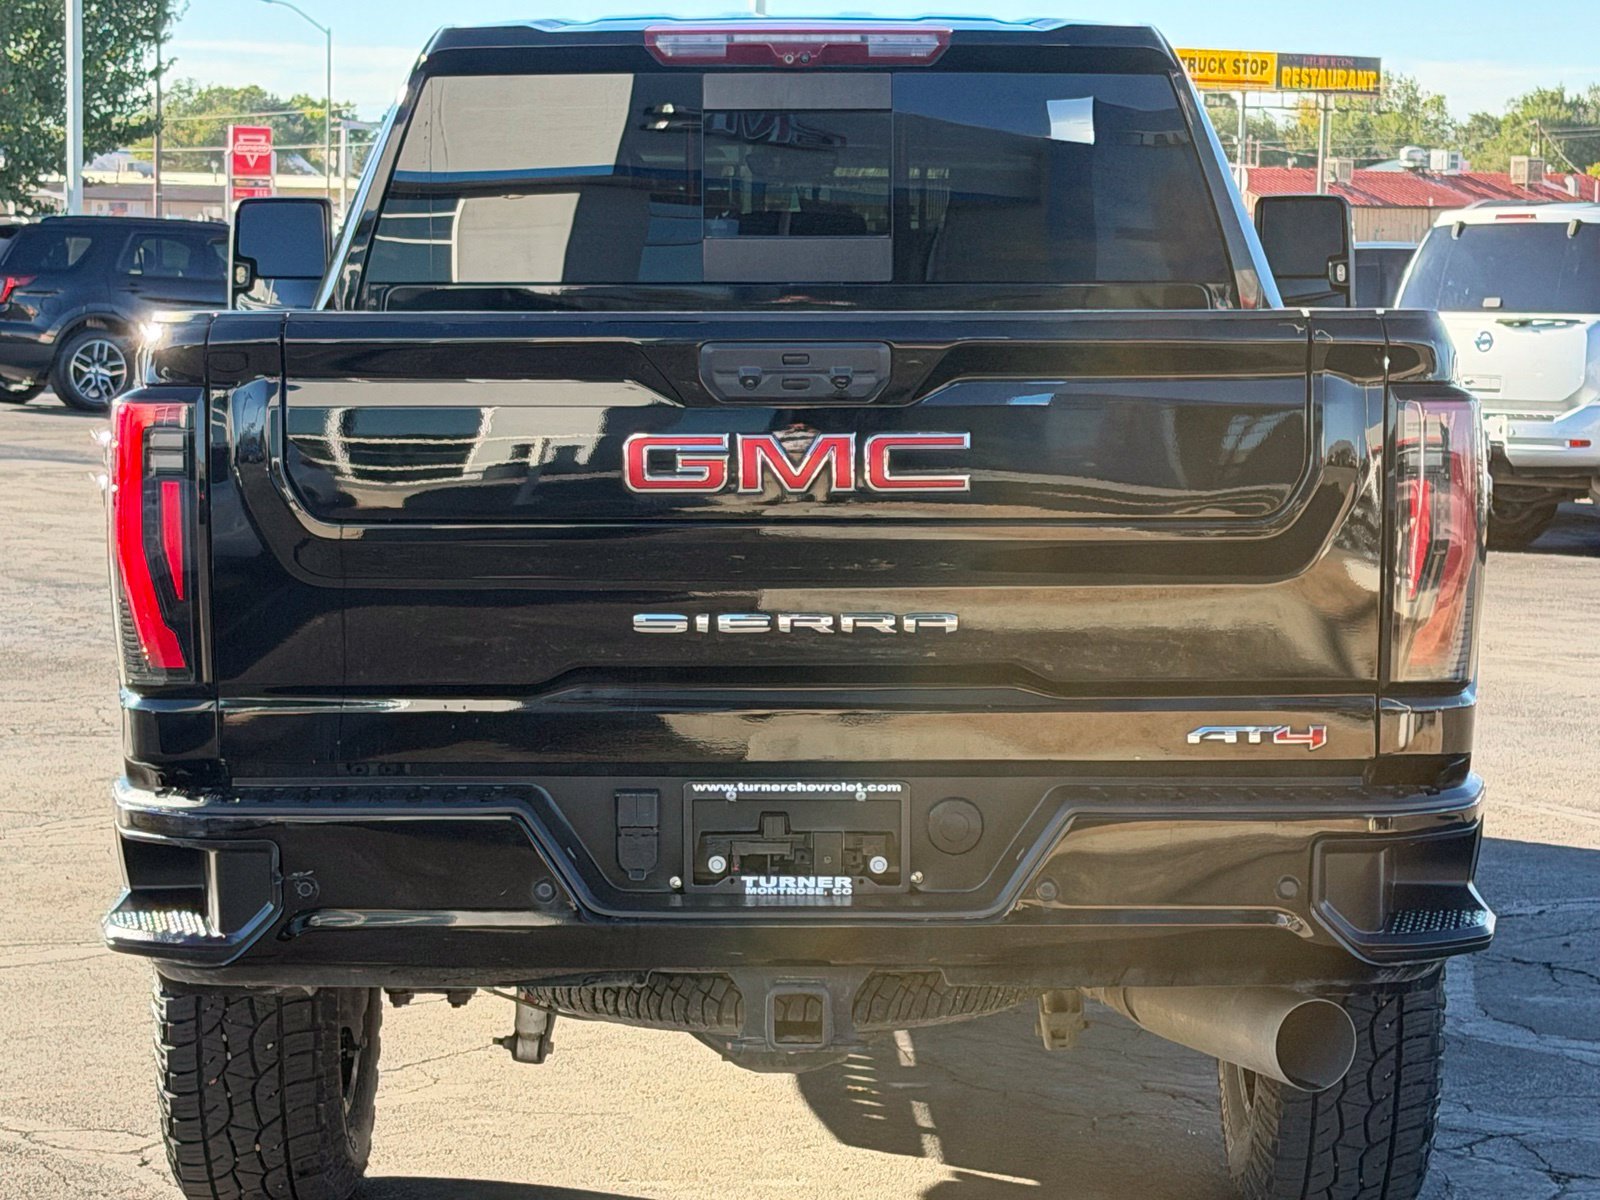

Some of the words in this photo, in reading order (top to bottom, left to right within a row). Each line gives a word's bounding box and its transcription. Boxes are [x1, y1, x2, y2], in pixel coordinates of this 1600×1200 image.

[1232, 57, 1269, 76] STOP
[1281, 66, 1377, 91] RESTAURANT
[624, 432, 971, 493] GMC
[632, 613, 959, 634] SIERRA
[1187, 725, 1327, 750] AT4
[692, 782, 902, 793] www.turnerchevrolet.com
[741, 876, 853, 888] TURNER
[832, 887, 852, 896] CO
